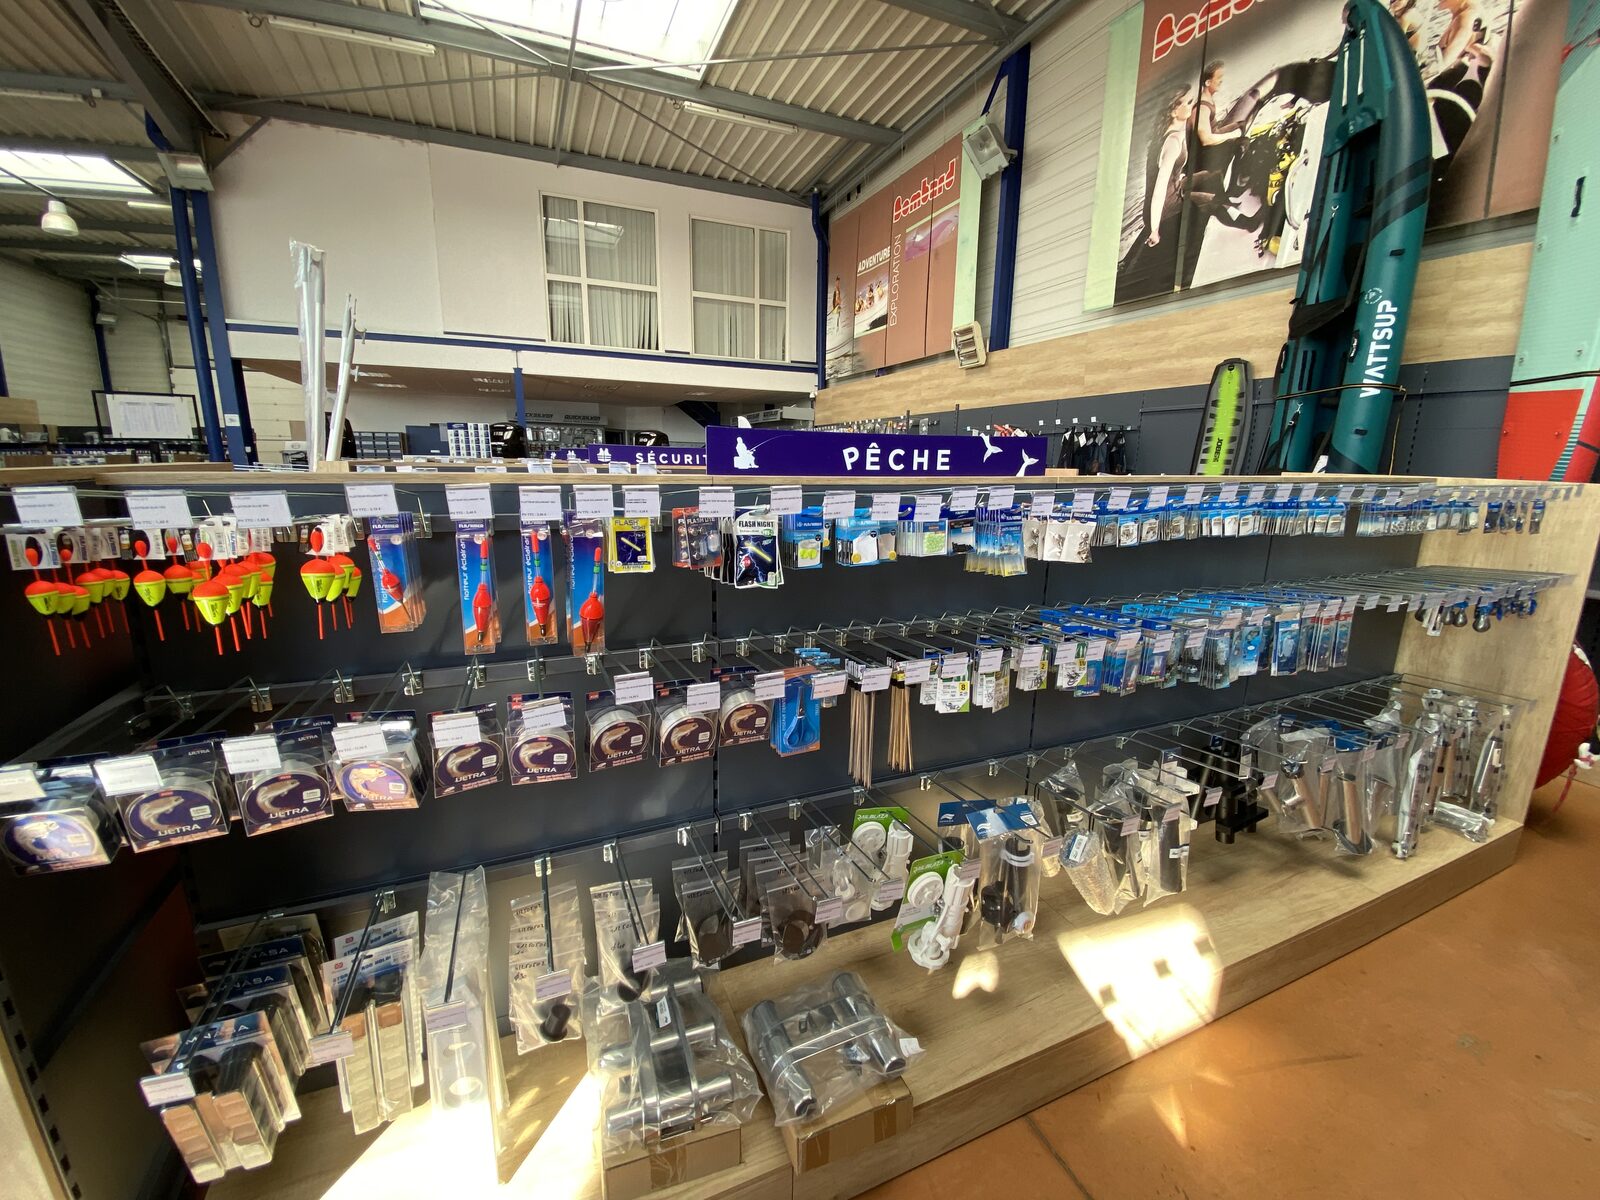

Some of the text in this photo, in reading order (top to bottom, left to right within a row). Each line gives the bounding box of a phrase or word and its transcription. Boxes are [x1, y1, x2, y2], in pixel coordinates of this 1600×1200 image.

[857, 246, 891, 273] ADVENTURE
[890, 233, 902, 327] EXPLORATION
[1359, 299, 1398, 398] WATTSUP
[842, 442, 952, 472] PÊCHE
[738, 520, 774, 528] FLASH NIGHT
[523, 535, 531, 566] éclairan
[460, 571, 470, 601] flotteur
[297, 734, 319, 742] ULTRA
[733, 729, 757, 737] ULTRA
[187, 748, 211, 756] ULTRA
[606, 749, 634, 759] ULTRA
[676, 746, 701, 755] ULTRA
[454, 771, 487, 783] ULTRA
[269, 806, 309, 819] ULTRA
[157, 822, 202, 837] ULTRA
